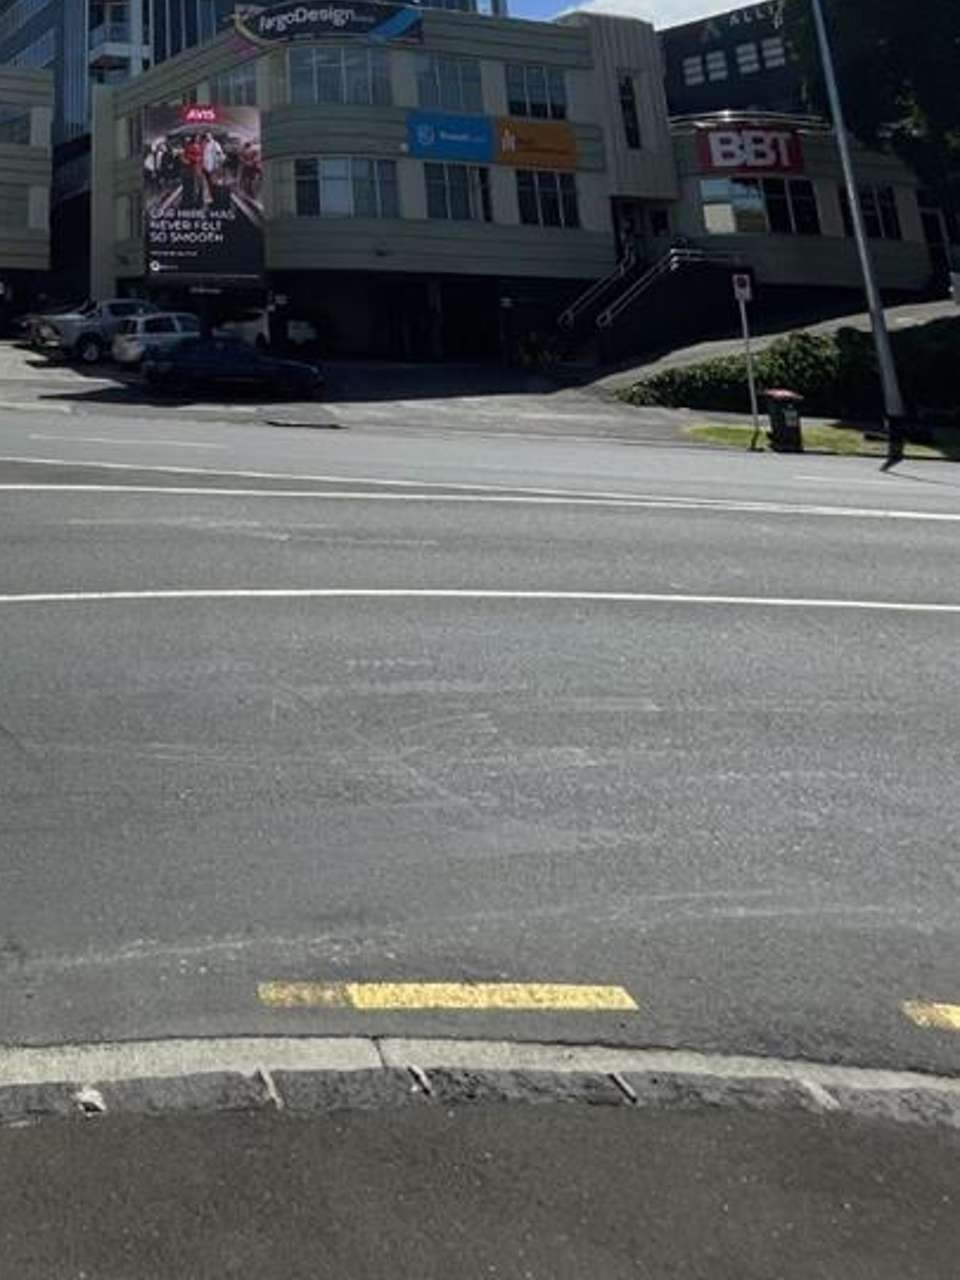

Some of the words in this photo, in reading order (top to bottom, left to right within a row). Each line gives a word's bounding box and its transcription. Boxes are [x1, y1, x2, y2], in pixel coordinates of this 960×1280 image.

[186, 108, 216, 121] AVIS
[708, 129, 793, 167] BBT
[209, 208, 236, 221] HAS
[149, 220, 192, 231] NEVER
[194, 220, 222, 231] FELT
[149, 231, 167, 243] SO
[169, 231, 224, 243] SMOOTH
